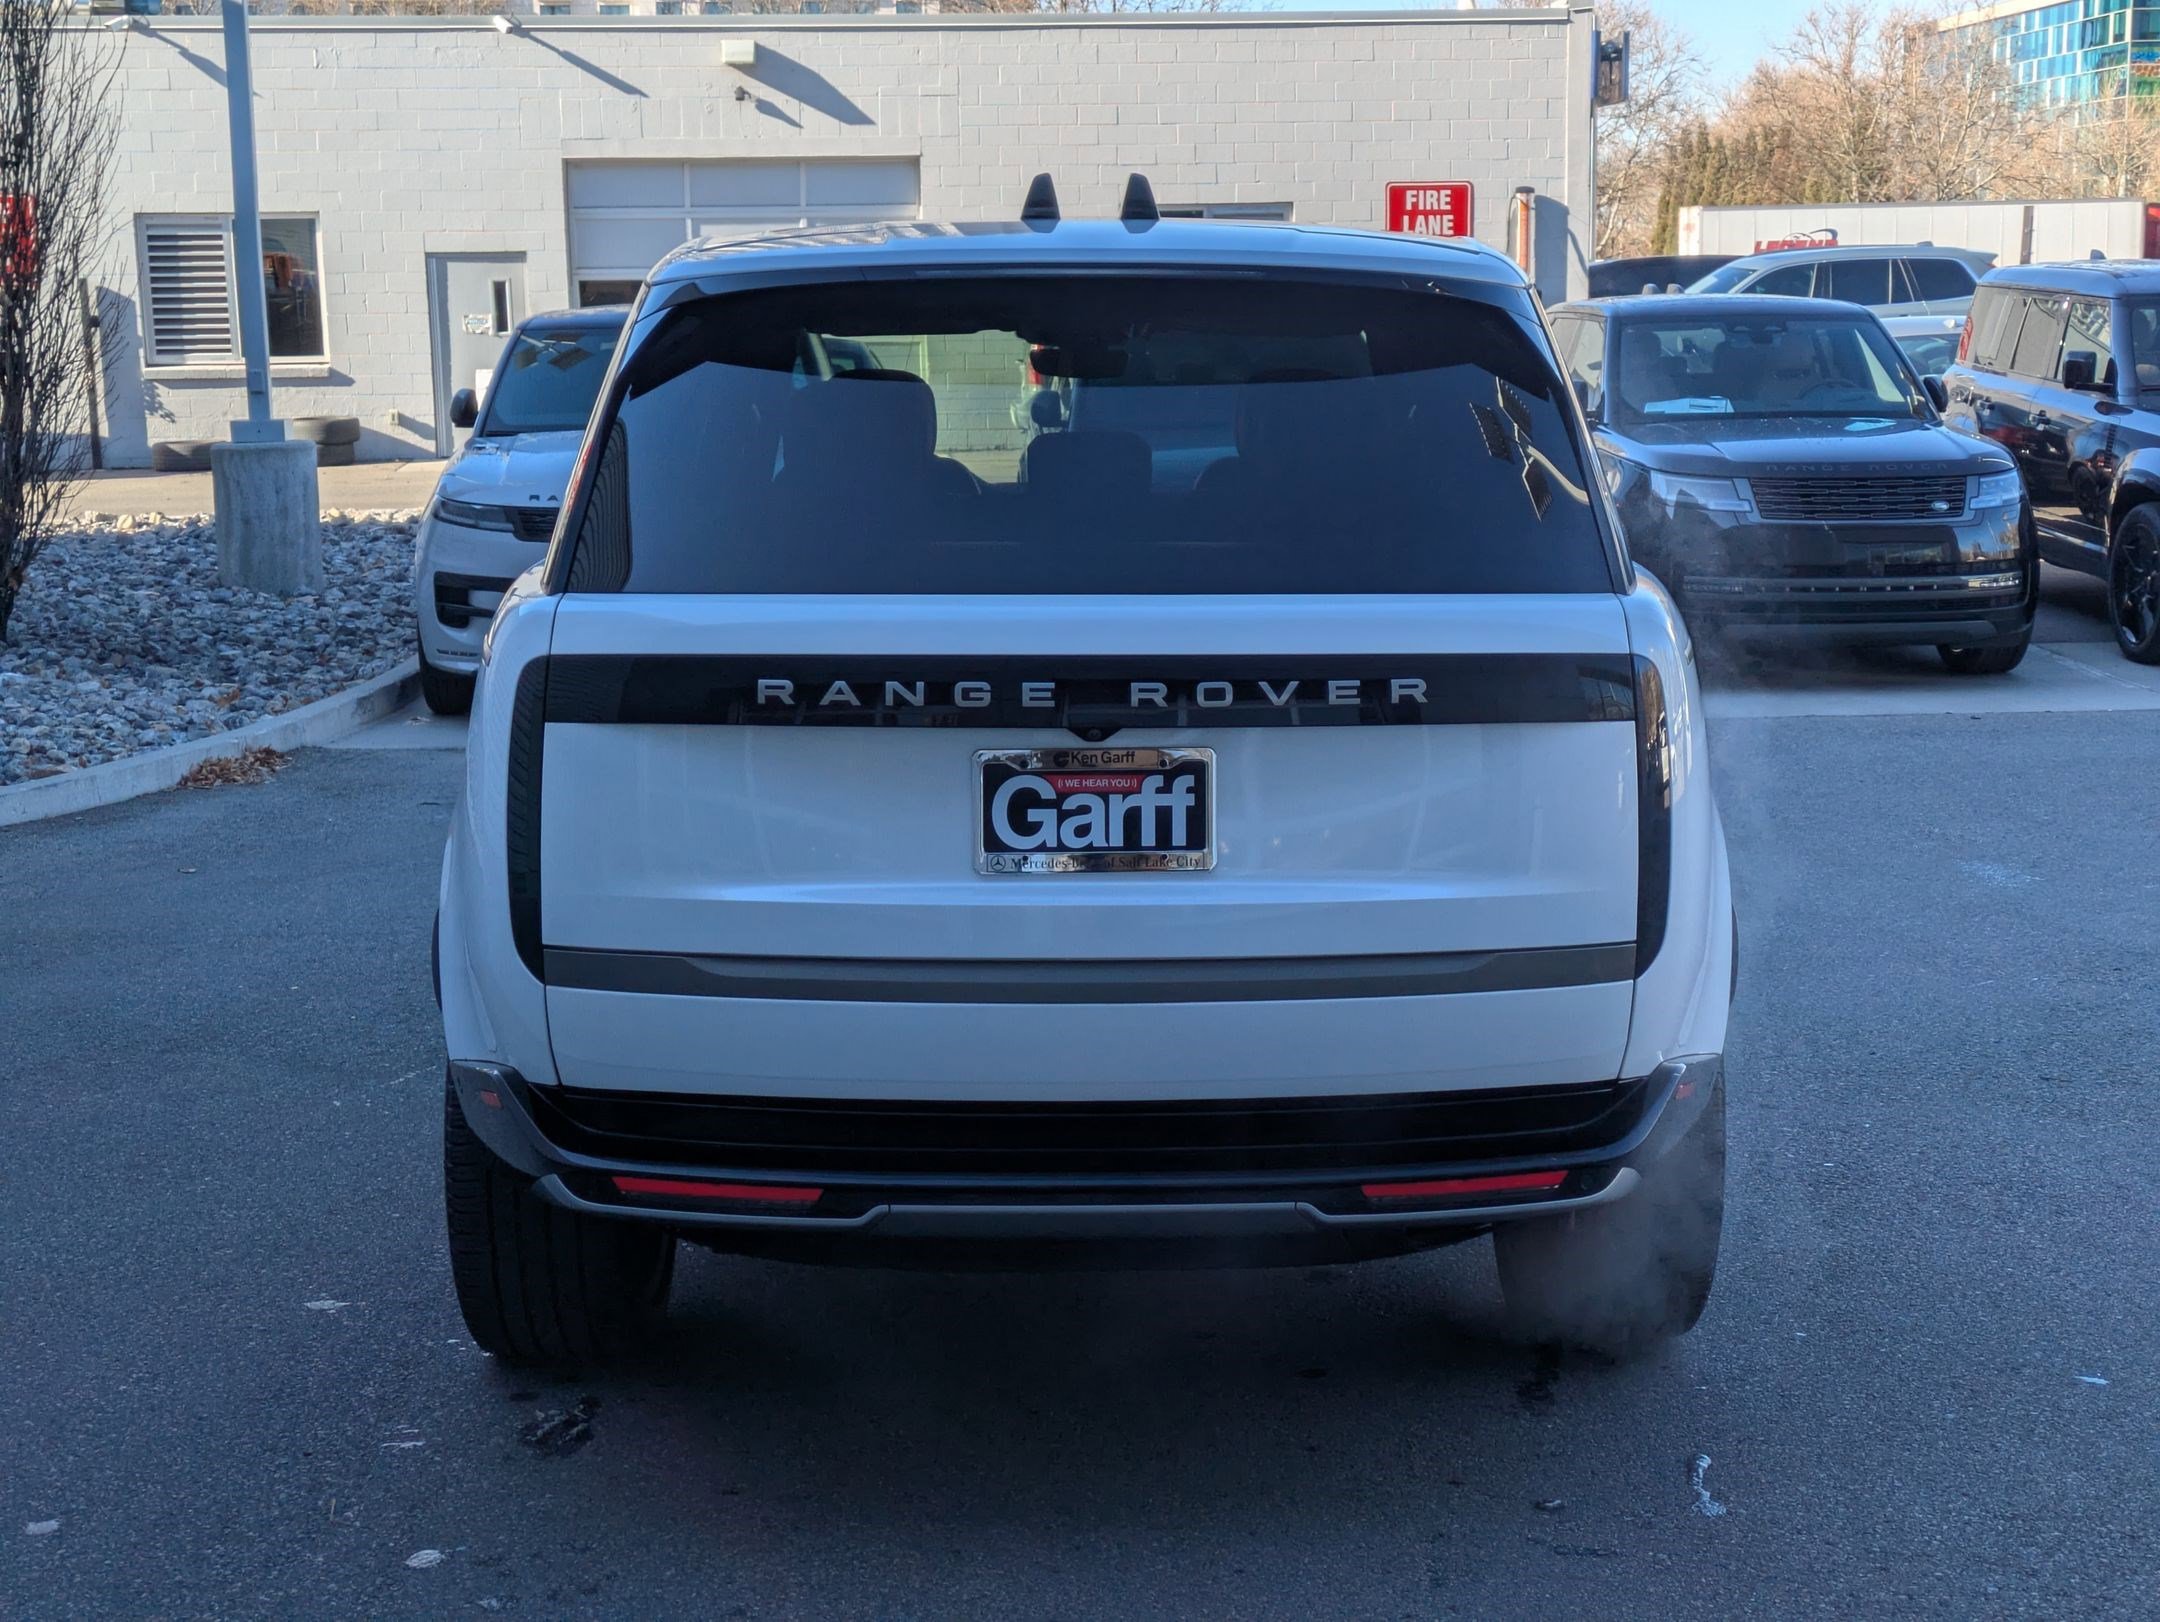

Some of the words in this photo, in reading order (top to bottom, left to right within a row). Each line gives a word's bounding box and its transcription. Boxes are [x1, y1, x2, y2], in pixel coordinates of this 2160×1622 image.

[1405, 189, 1452, 211] FIRE
[1402, 214, 1455, 236] LANE
[757, 679, 1056, 708] RANGE
[1130, 678, 1429, 708] ROVER
[1070, 750, 1099, 764] Ken
[1100, 750, 1136, 764] Garff
[1064, 779, 1081, 788] WE
[1082, 779, 1109, 788] HEAR
[1110, 779, 1131, 788] YOU
[991, 774, 1196, 850] Garff
[1175, 855, 1201, 869] City
